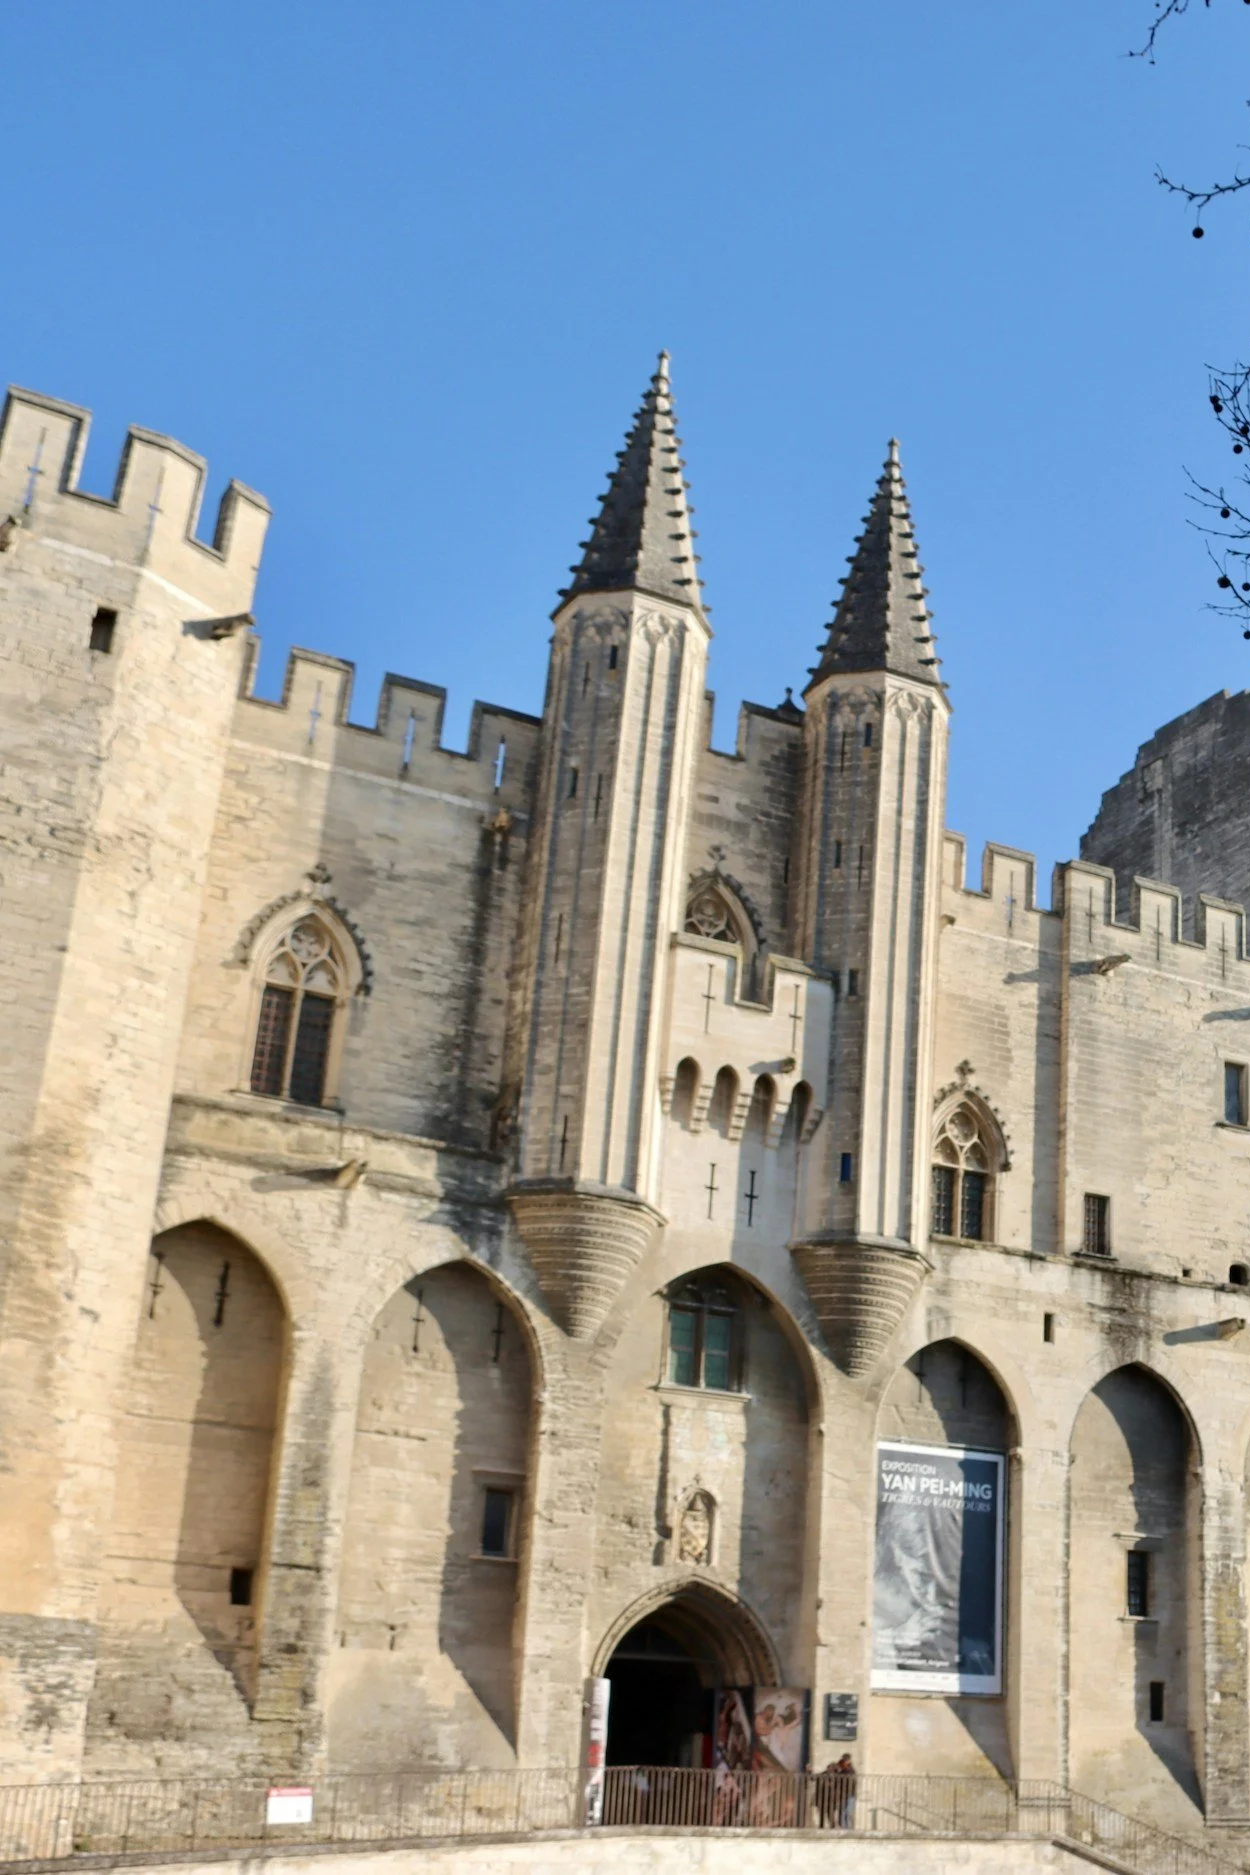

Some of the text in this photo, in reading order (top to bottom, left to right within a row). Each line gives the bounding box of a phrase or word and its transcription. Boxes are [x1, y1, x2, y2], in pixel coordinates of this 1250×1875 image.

[883, 1461, 936, 1475] EXPOSITION
[881, 1473, 992, 1500] YAN PEI-MING
[882, 1493, 922, 1504] TIGRES
[932, 1498, 991, 1512] VAUTOURS
